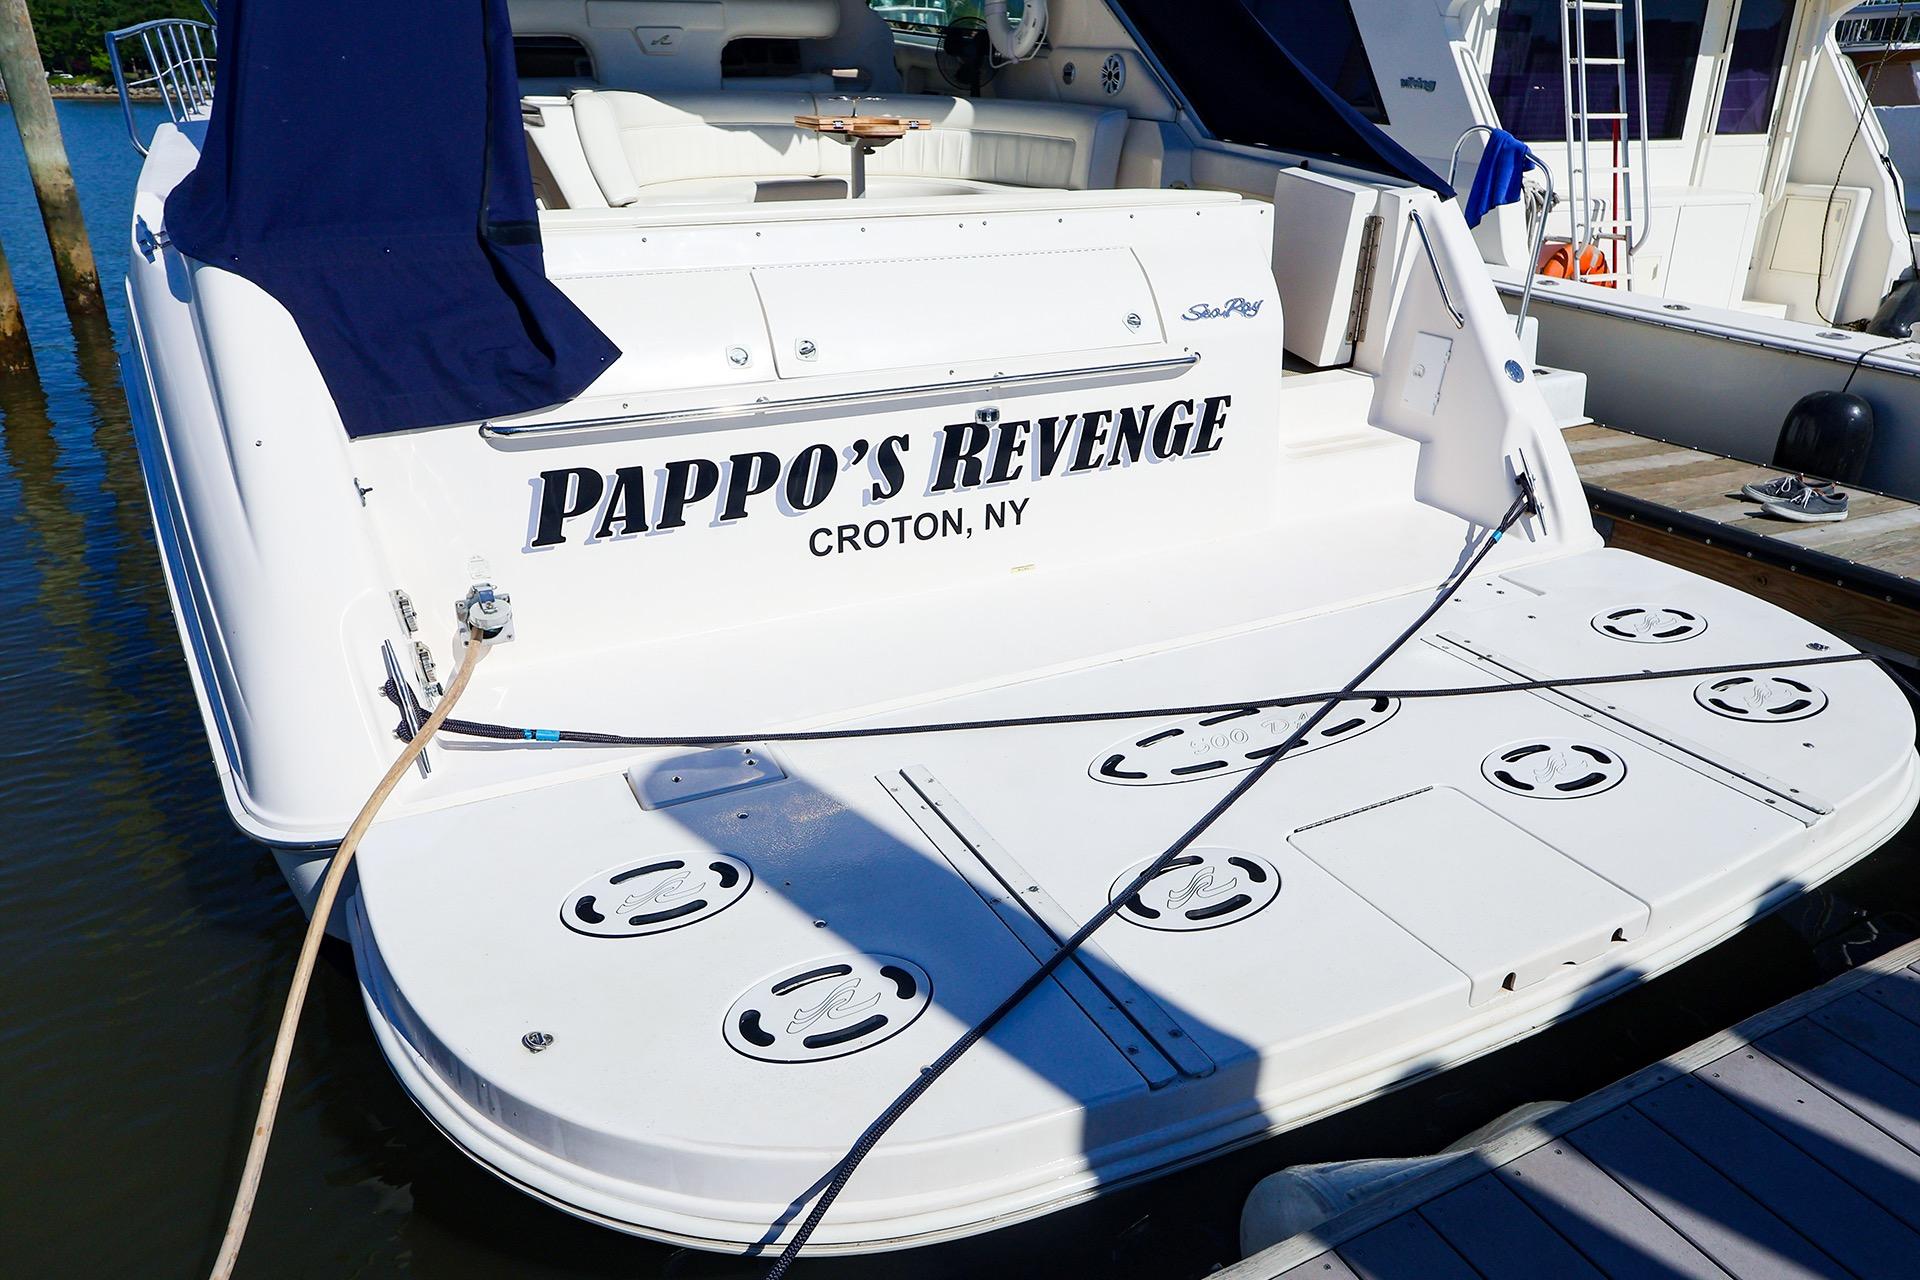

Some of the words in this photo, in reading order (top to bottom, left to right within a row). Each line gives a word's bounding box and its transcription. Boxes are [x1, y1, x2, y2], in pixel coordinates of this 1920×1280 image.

[522, 433, 910, 553] PAPPO'S
[924, 394, 1232, 497] REVENGE
[809, 507, 973, 557] CROTON,
[985, 497, 1031, 529] NY
